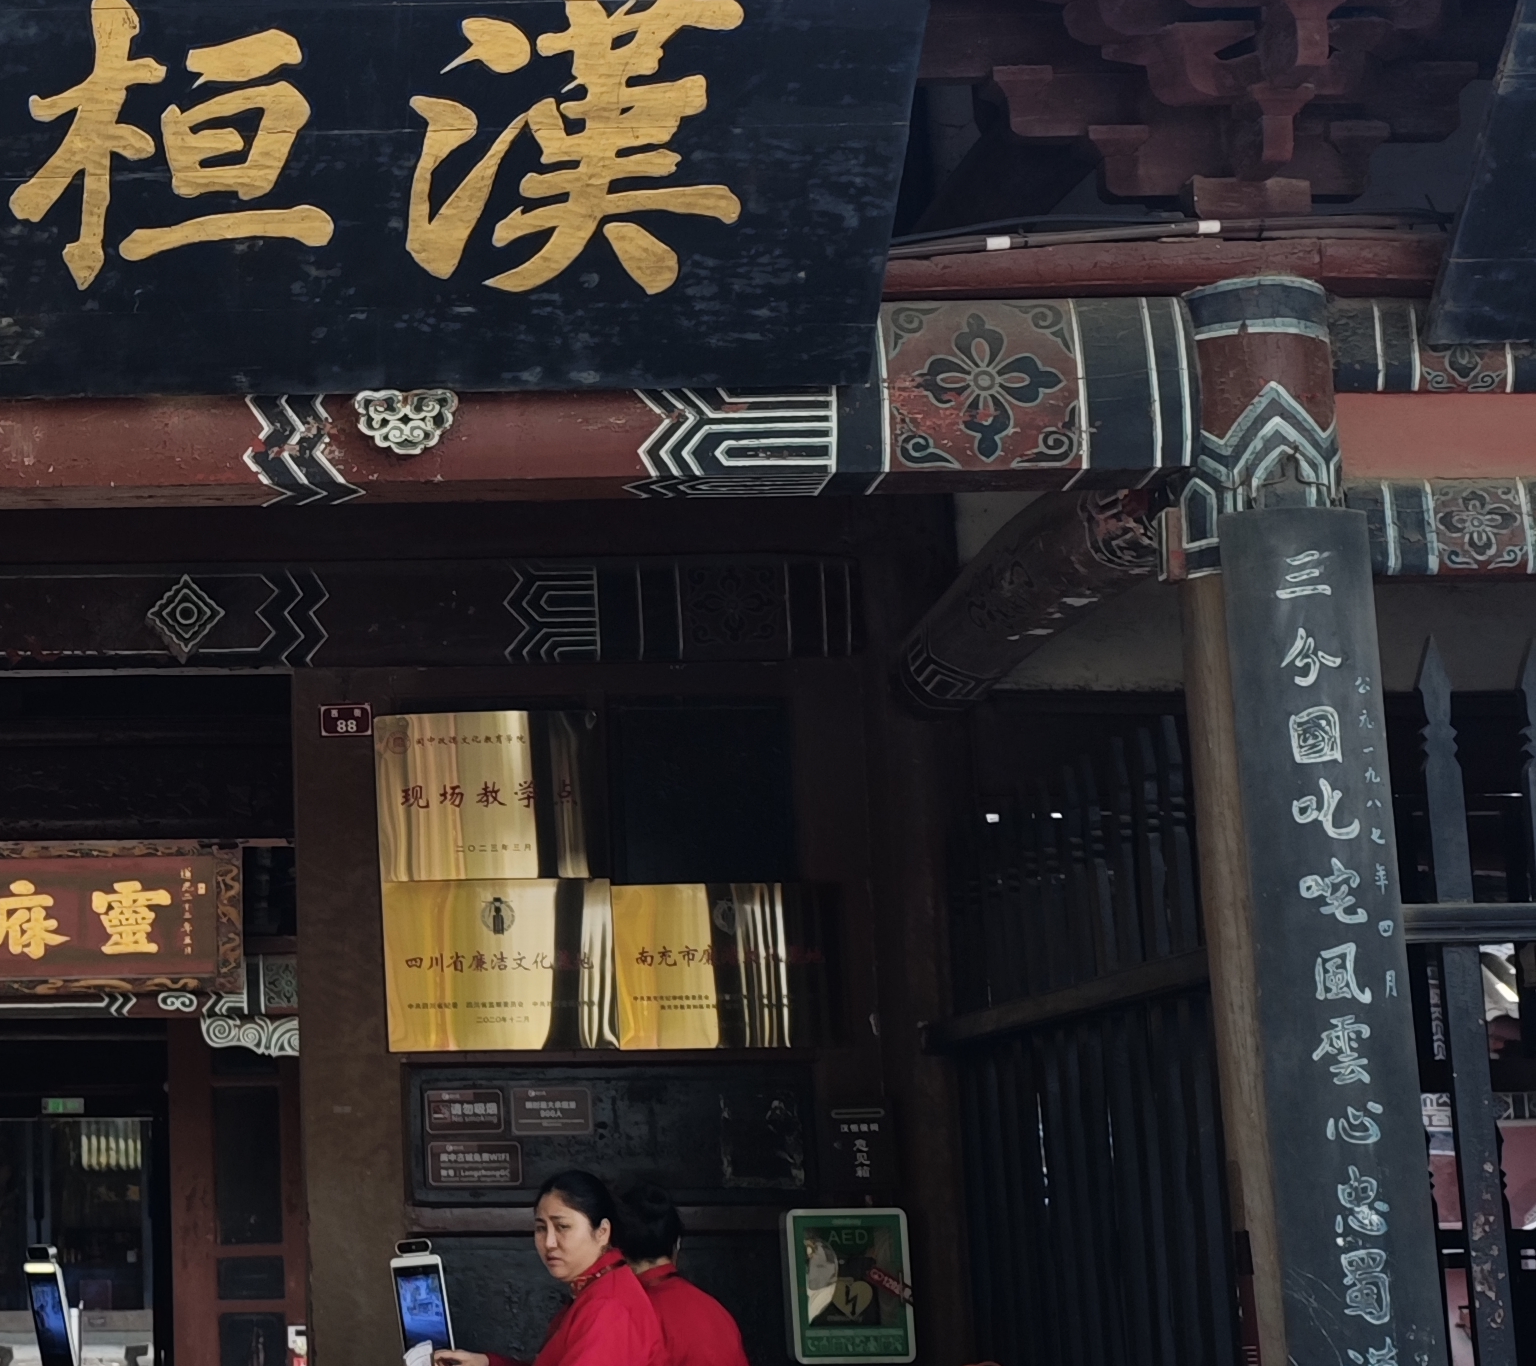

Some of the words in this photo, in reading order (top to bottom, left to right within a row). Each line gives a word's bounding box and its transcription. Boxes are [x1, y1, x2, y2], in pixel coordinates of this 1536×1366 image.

[335, 719, 358, 733] 88
[400, 779, 580, 810] 现场教学点
[404, 950, 595, 973] 四川省廉洁文化基地
[827, 1229, 869, 1245] AED
